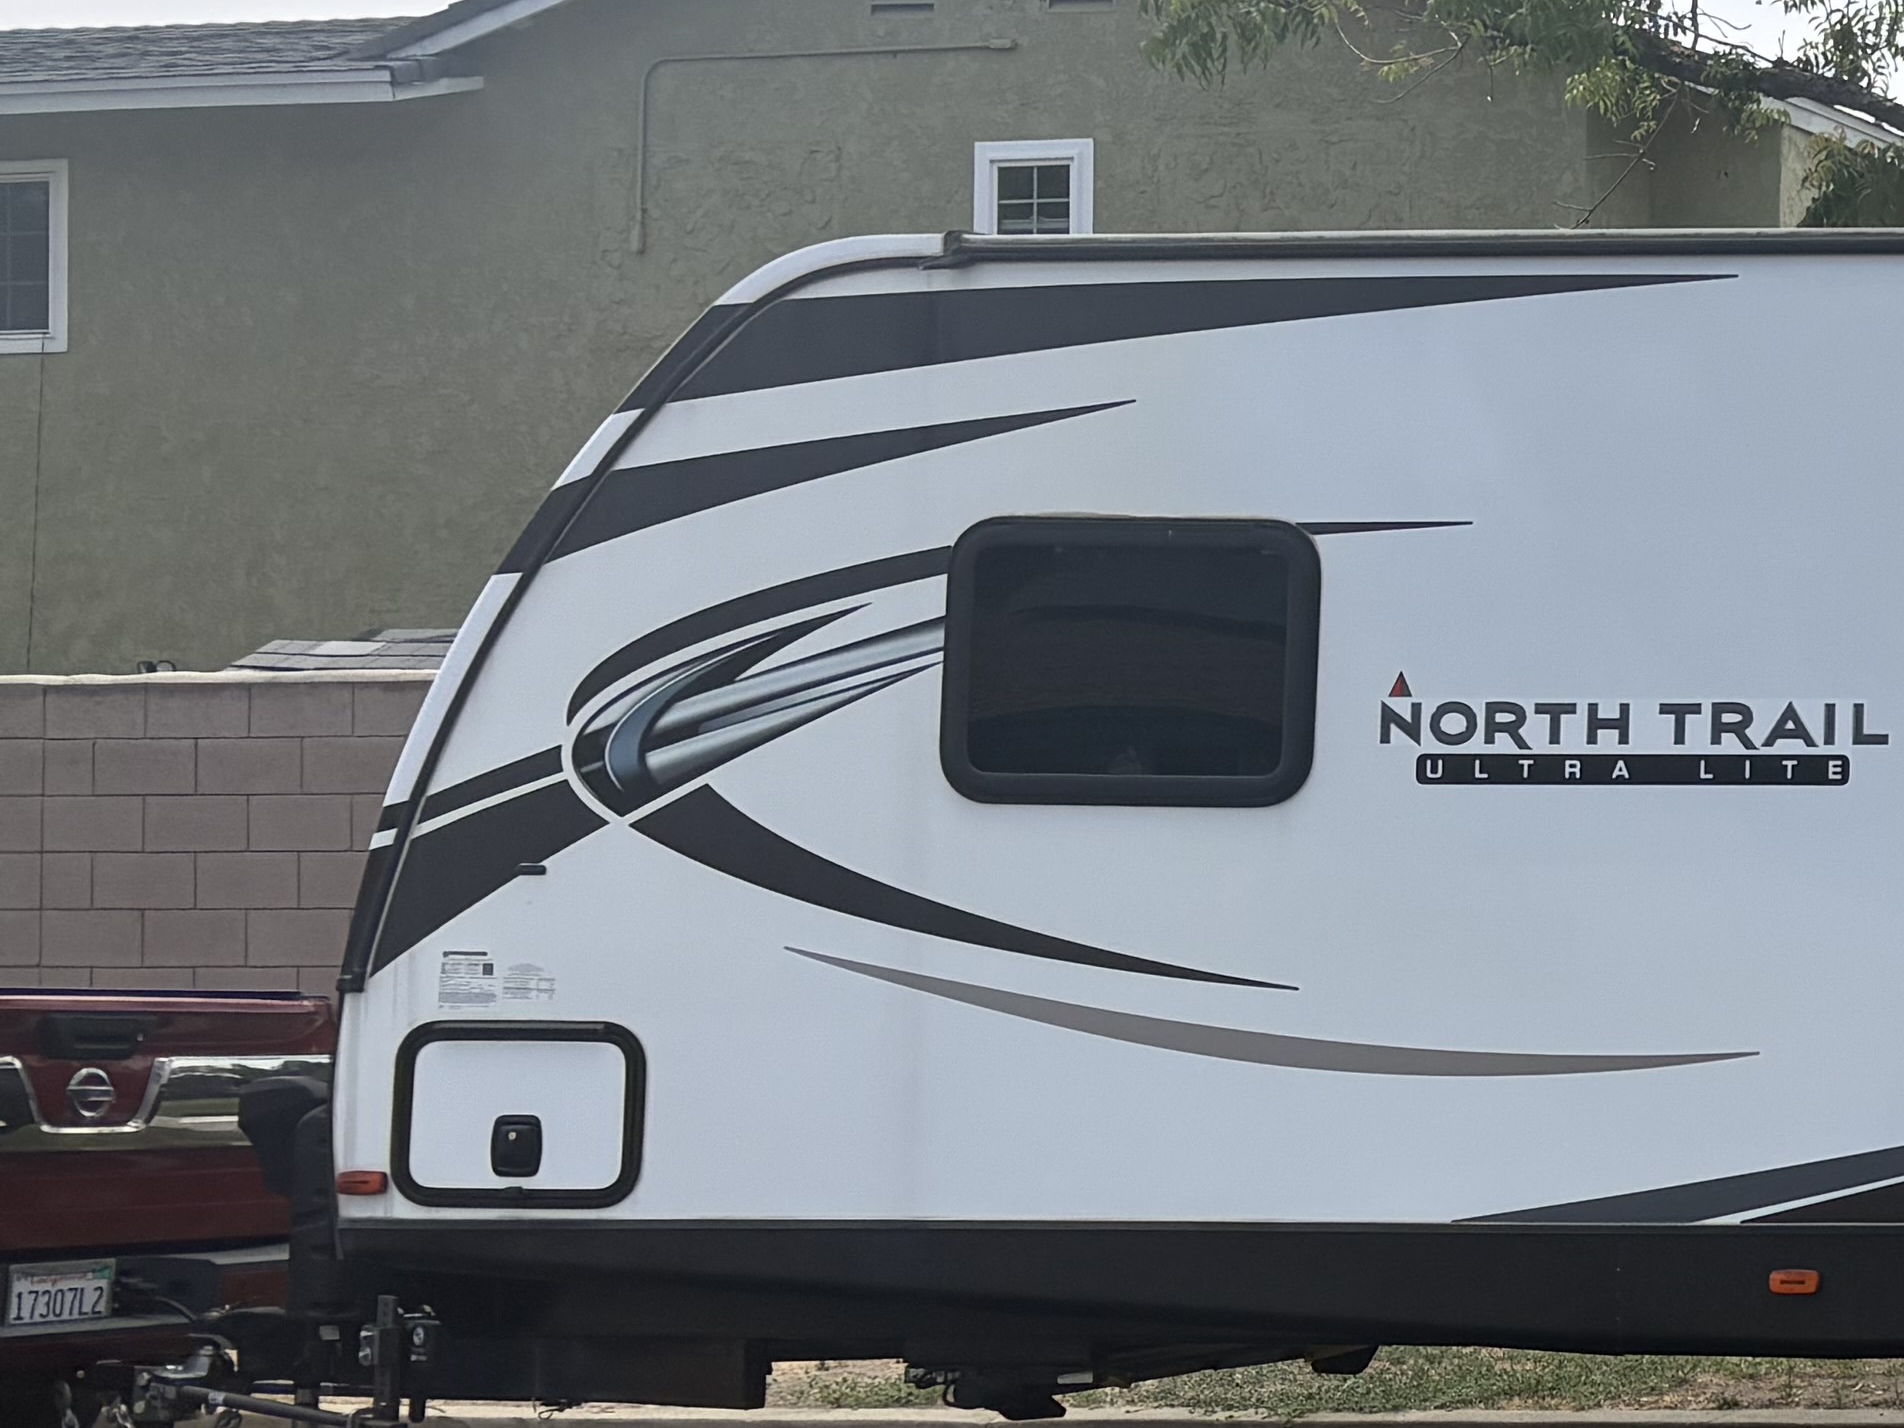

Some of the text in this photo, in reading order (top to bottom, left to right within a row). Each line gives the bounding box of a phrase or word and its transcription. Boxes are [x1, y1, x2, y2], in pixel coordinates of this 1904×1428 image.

[1379, 698, 1890, 751] NORTH TRAIL
[1424, 758, 1844, 780] ULTRA LITE
[12, 1285, 104, 1322] 17307L2
